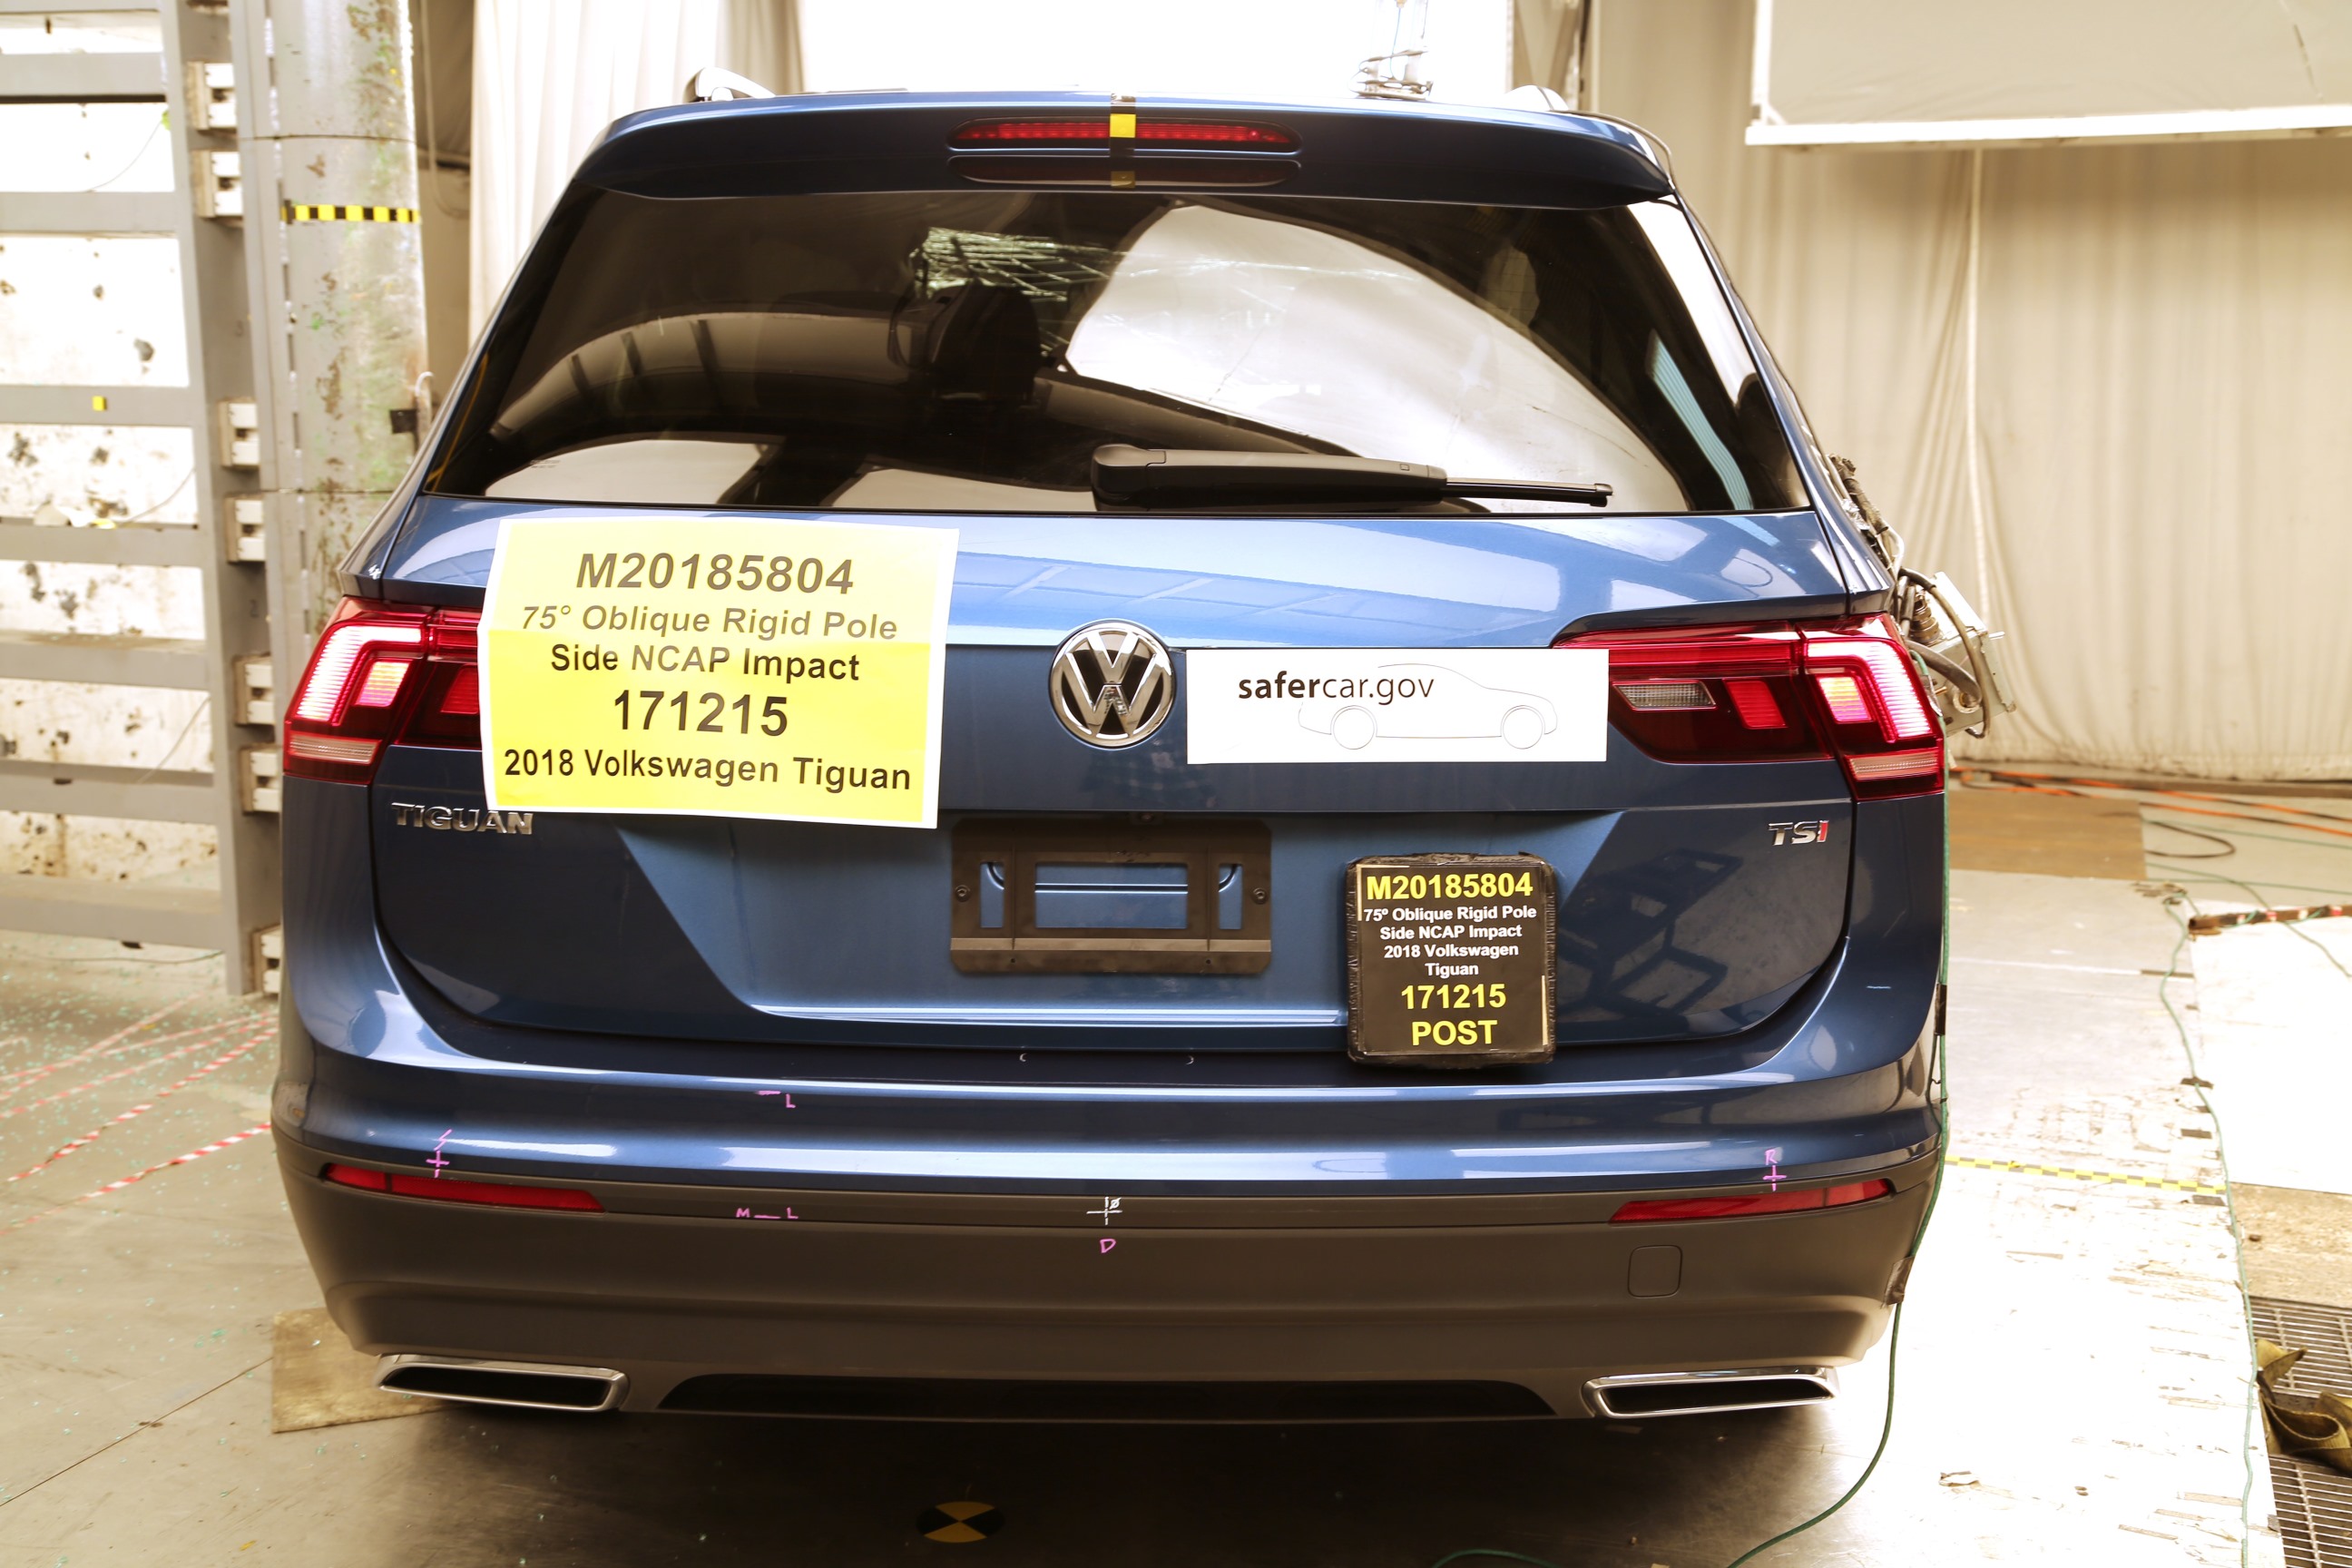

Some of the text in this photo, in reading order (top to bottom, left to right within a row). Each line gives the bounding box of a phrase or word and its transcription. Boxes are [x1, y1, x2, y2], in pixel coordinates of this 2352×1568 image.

[576, 553, 854, 594] M20185804
[522, 604, 898, 642] 75° Oblique Rigid Pole
[551, 643, 860, 684] Side NCAP Impact
[1238, 670, 1436, 706] safercar.gov
[614, 689, 788, 736] 171215
[505, 749, 911, 794] 2018 Volkswagen Tiguan
[391, 802, 534, 835] TIGUAN
[1769, 820, 1829, 846] TSI
[1367, 872, 1534, 900] M20185804
[1392, 907, 1454, 924] Oblique
[1456, 906, 1498, 922] Rigid
[1502, 905, 1538, 919] Pole
[1379, 924, 1523, 941] Side NCAP Impact
[1384, 944, 1519, 959] 2018 Volkswagen
[1425, 962, 1479, 979] Tiguan
[1401, 983, 1507, 1010] 171215
[1411, 1019, 1498, 1046] POST
